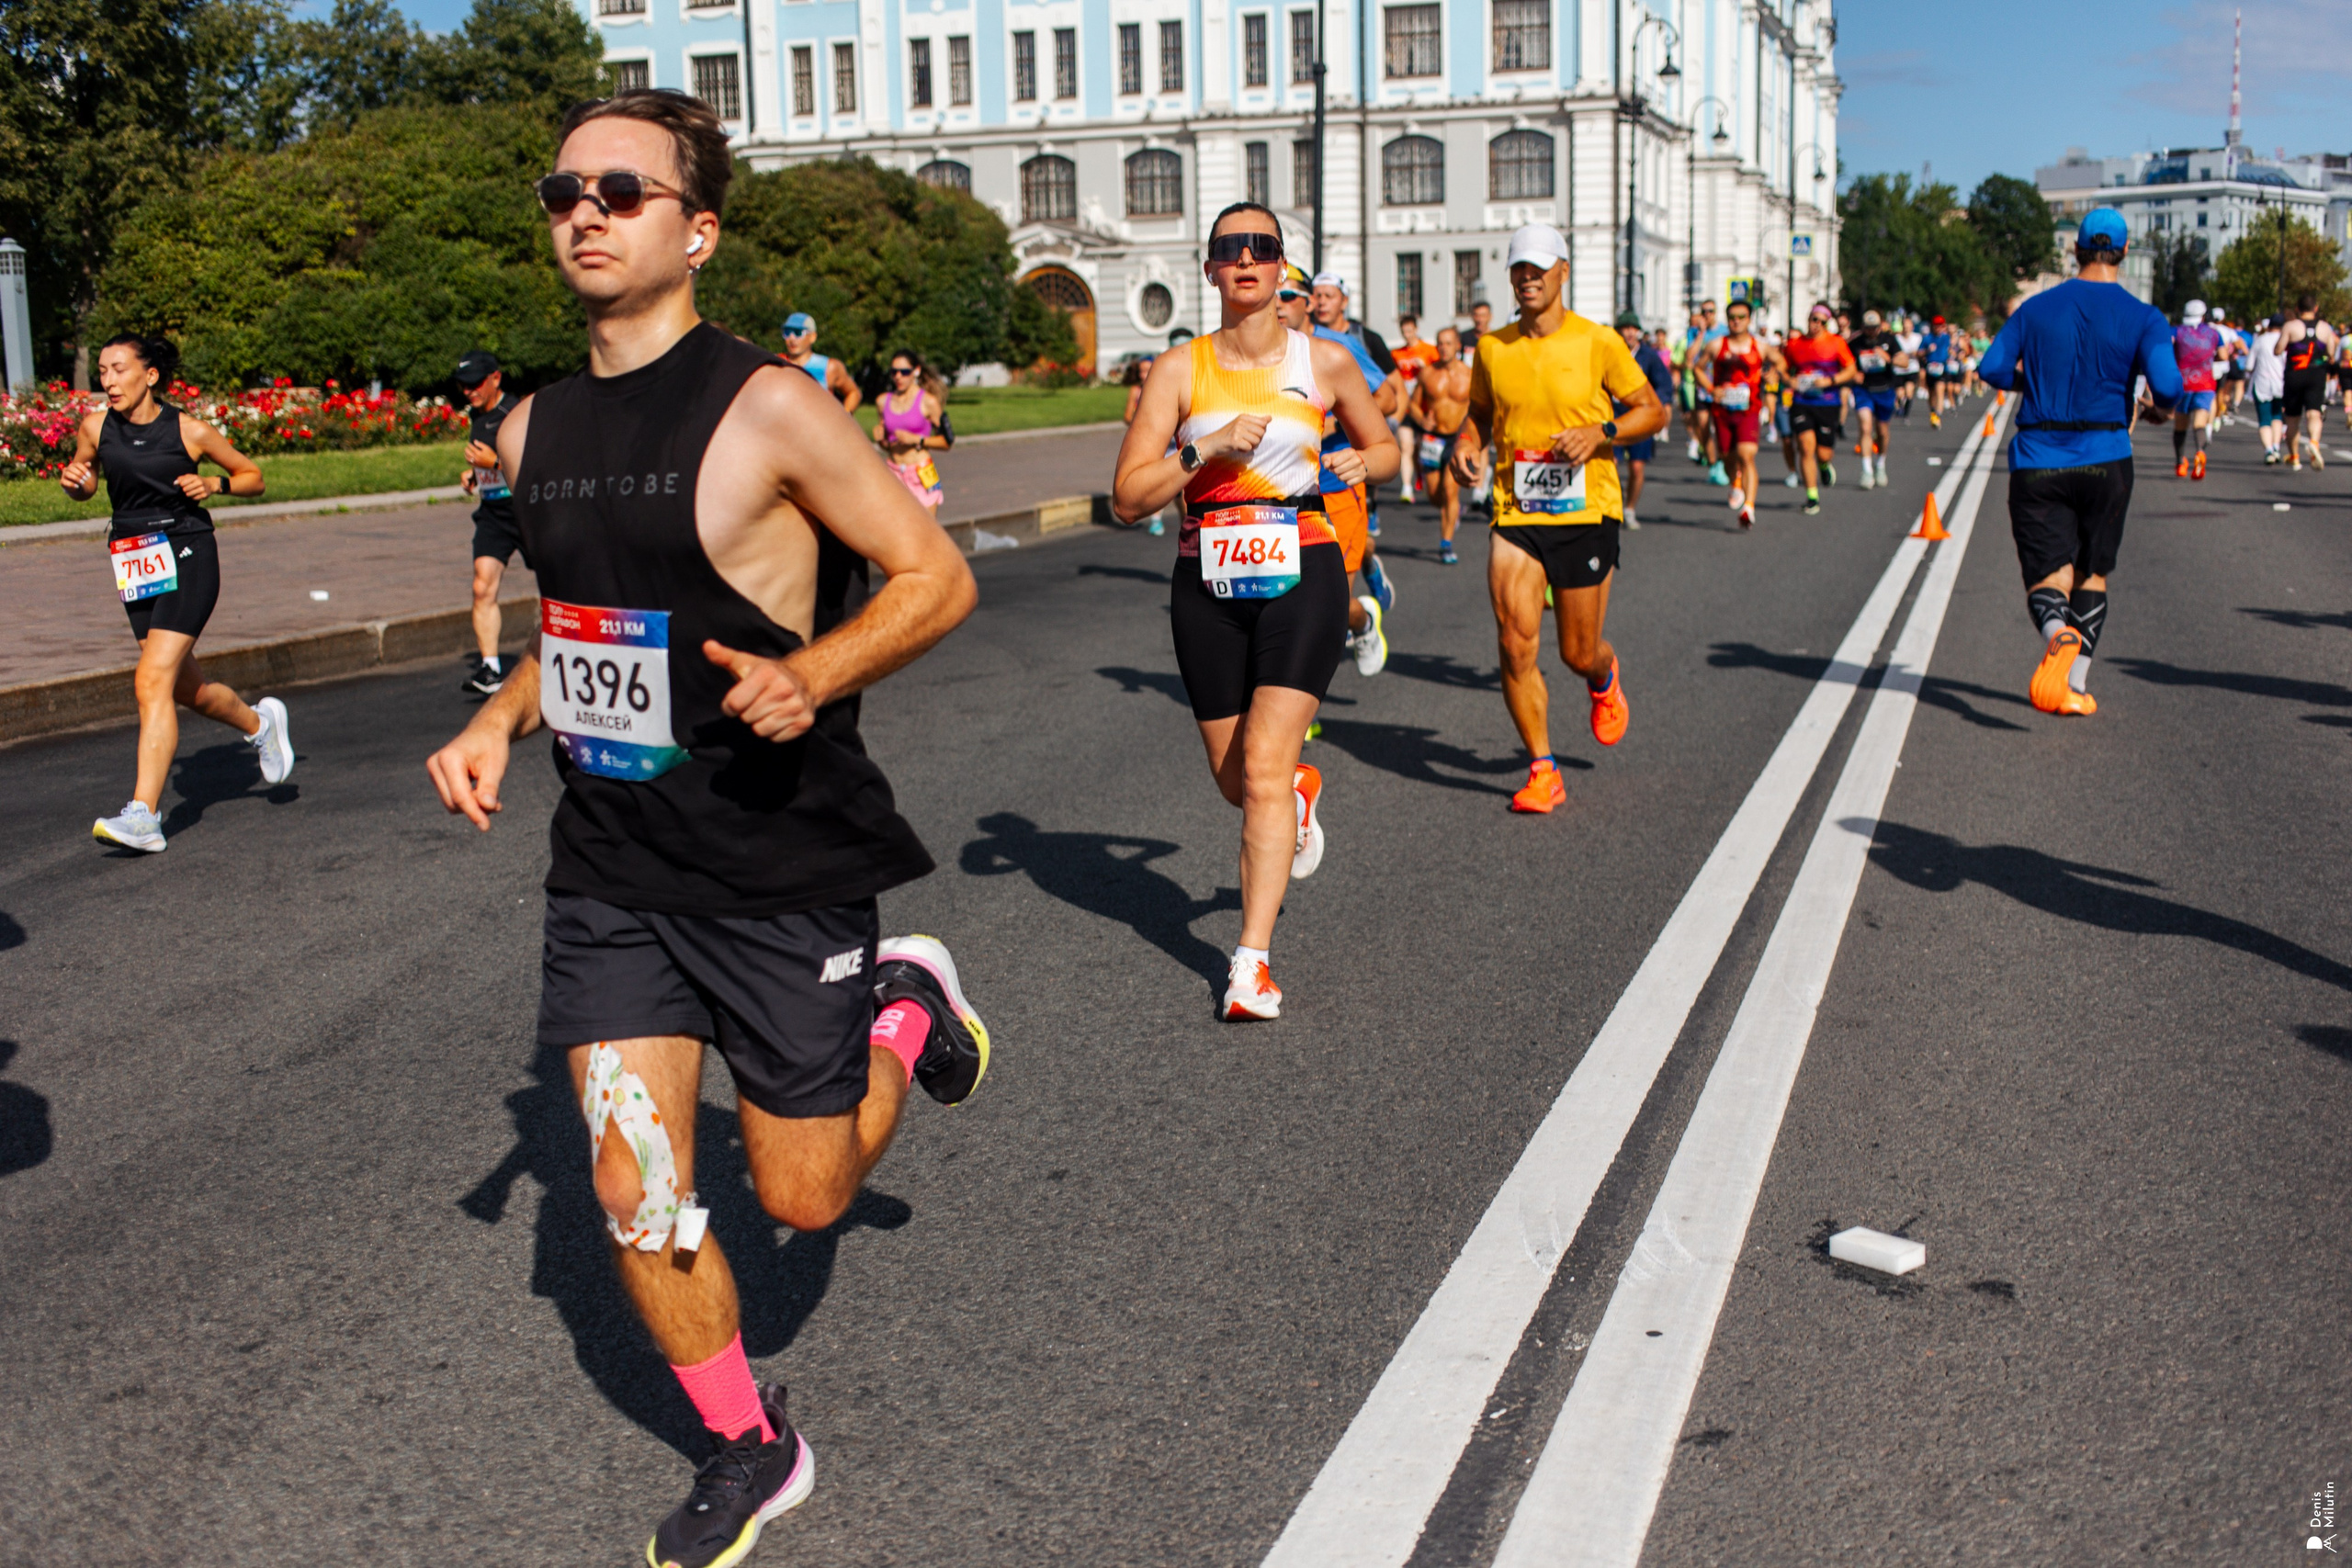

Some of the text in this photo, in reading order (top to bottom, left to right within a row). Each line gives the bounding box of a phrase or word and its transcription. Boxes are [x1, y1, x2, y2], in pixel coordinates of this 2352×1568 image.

[529, 472, 679, 504] BORN TO BE
[1524, 468, 1573, 488] 4451
[1255, 511, 1270, 521] 21,1
[1521, 500, 1531, 512] C
[1213, 537, 1285, 567] 7484
[121, 553, 166, 580] 7761
[127, 588, 135, 599] D
[1216, 581, 1227, 595] D
[599, 618, 622, 637] 21,1
[553, 653, 650, 714] 1396
[575, 711, 633, 732] АЛЕКСЕЙ
[819, 946, 865, 984] NIKE
